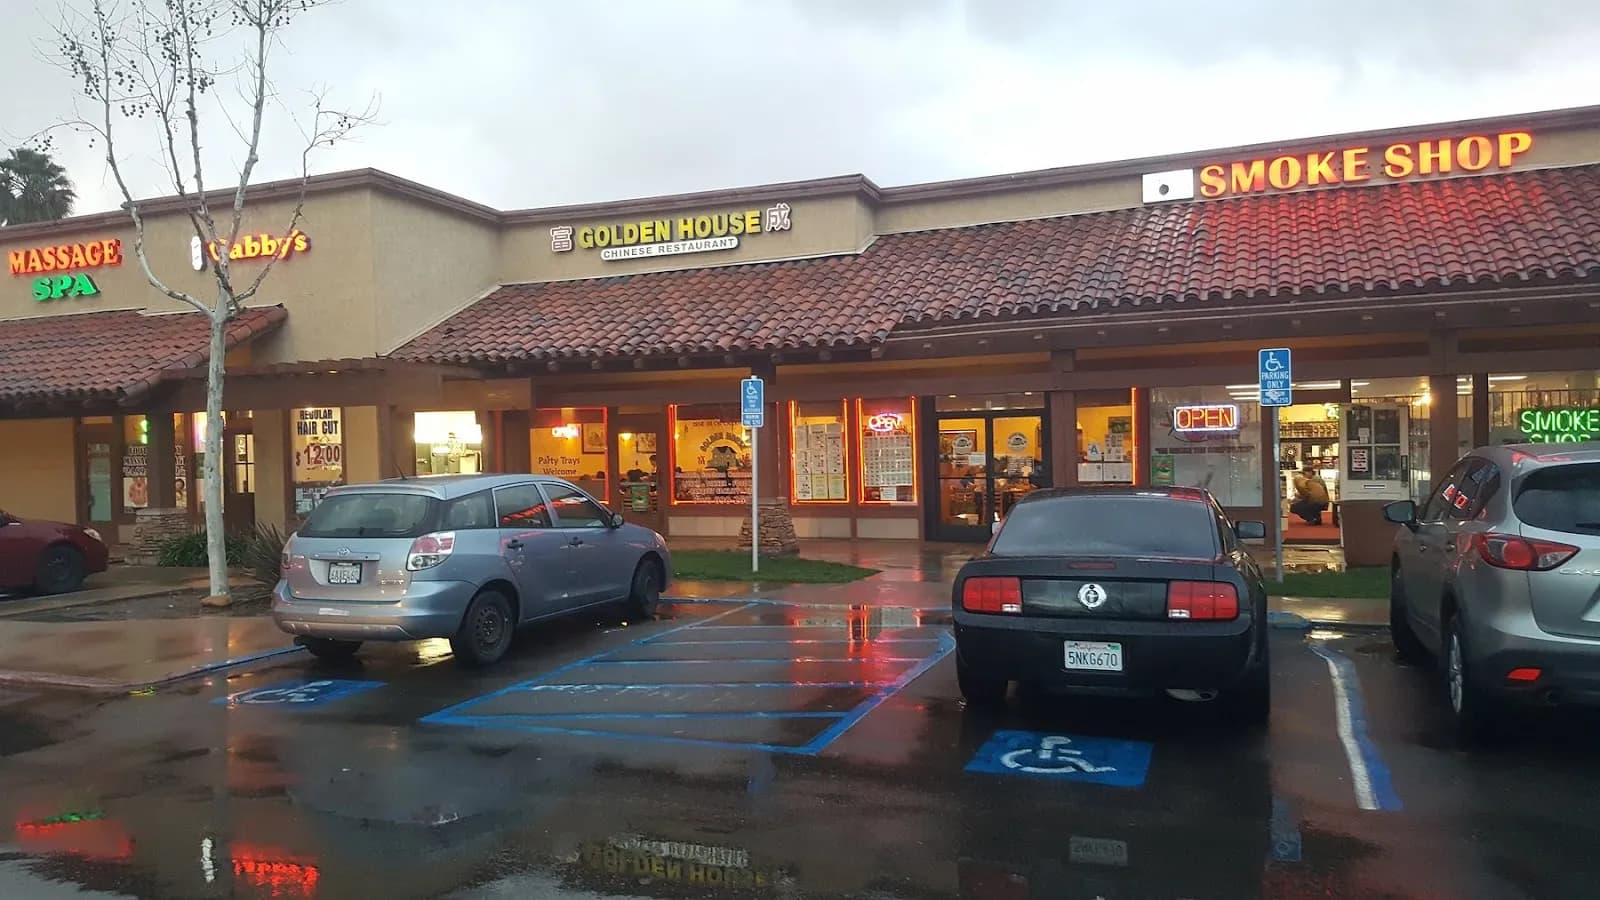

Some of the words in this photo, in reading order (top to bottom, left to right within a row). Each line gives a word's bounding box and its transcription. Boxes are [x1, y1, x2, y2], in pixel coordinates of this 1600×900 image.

[1200, 147, 1369, 198] SMOKE
[1383, 132, 1533, 177] SHOP
[766, 202, 792, 232] 成
[550, 226, 573, 252] 富
[579, 220, 671, 248] GOLDEN
[679, 210, 761, 239] HOUSE
[8, 239, 121, 274] MASSAGE
[603, 246, 653, 259] CHINESE
[658, 238, 735, 254] RESTAURANT
[32, 272, 98, 301] SPA
[1261, 371, 1289, 380] PARKING
[1266, 380, 1284, 389] ONLY
[301, 410, 332, 420] REGULAR
[869, 417, 901, 430] OPEN
[1176, 407, 1233, 429] OPEN
[1520, 409, 1600, 433] SMOKE
[297, 421, 317, 435] HAIR
[322, 421, 338, 434] CUT
[538, 456, 559, 466] Party
[560, 456, 581, 466] Trays
[1068, 651, 1118, 666] 5NKG670
